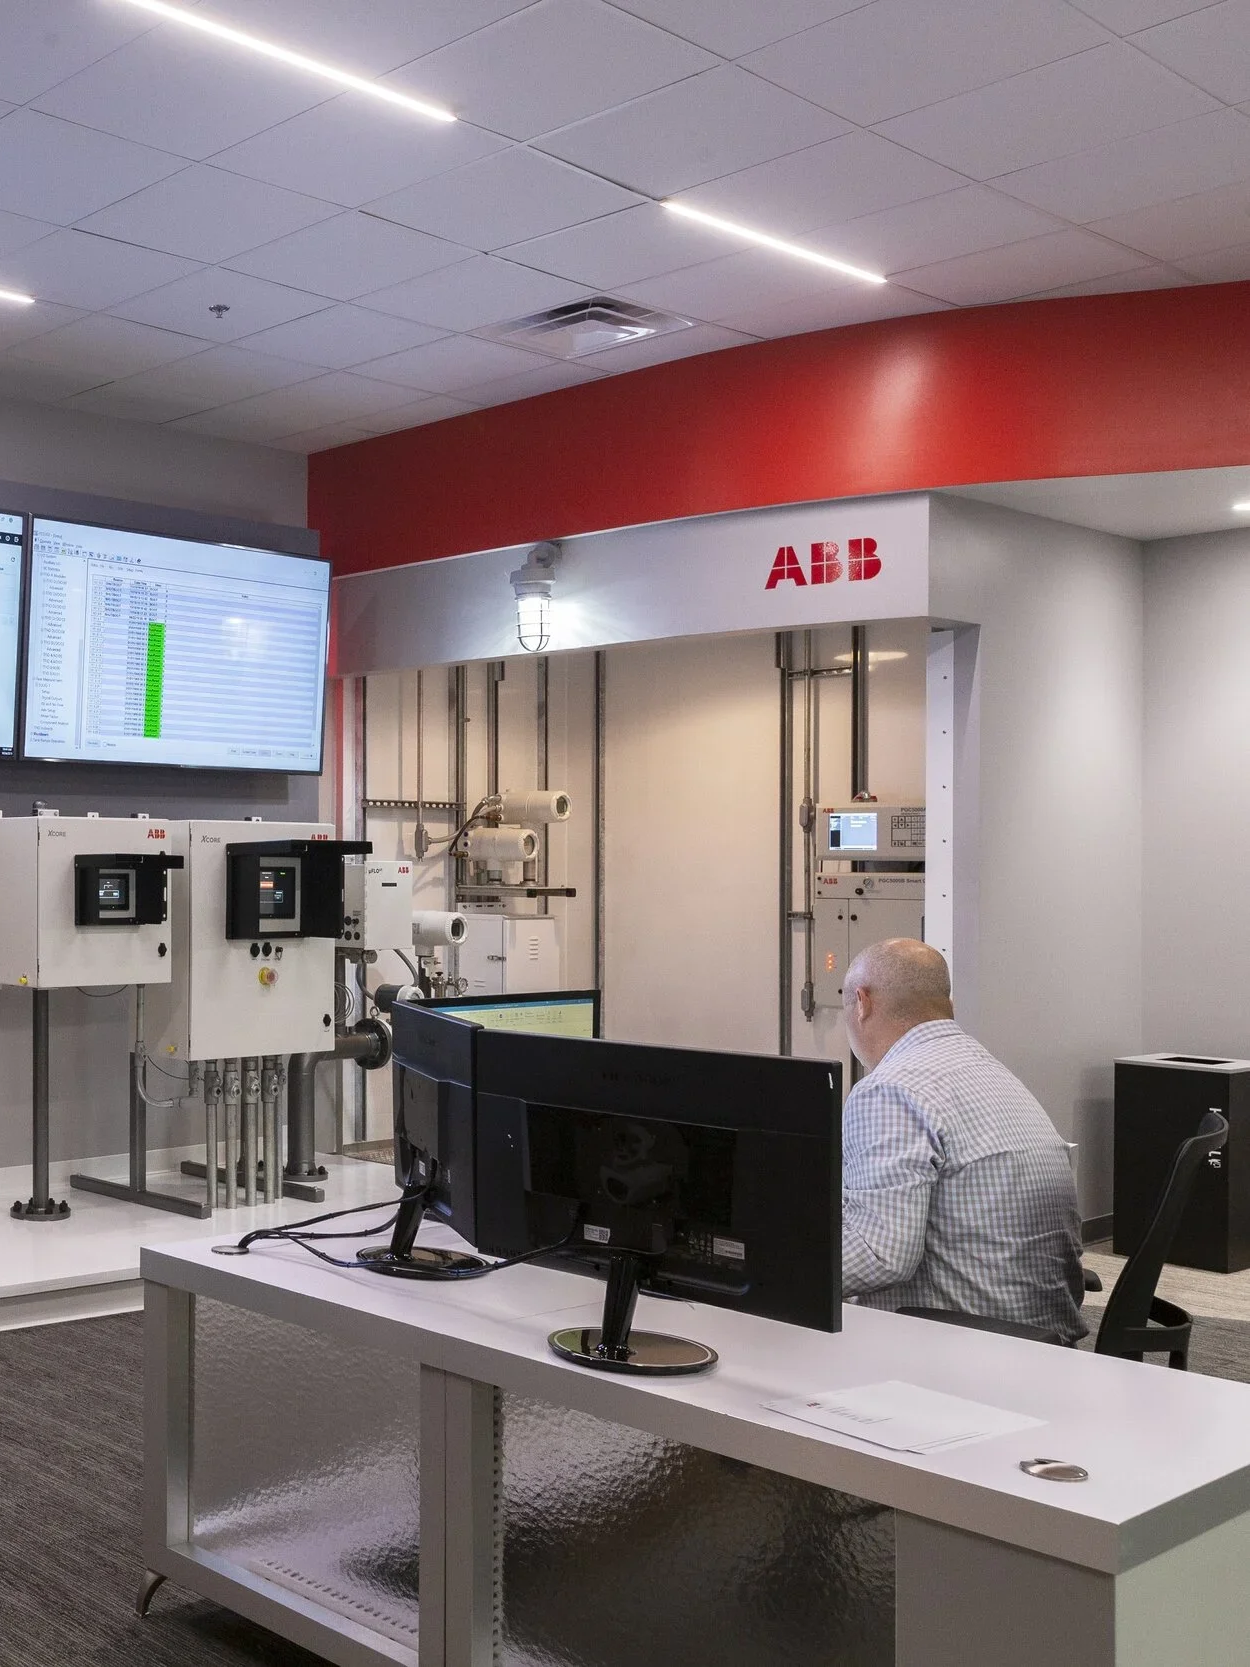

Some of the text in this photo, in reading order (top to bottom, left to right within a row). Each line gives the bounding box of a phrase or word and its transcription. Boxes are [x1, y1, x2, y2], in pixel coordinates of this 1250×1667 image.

[764, 537, 882, 590] ABB
[147, 829, 165, 839] ABB
[397, 866, 410, 874] ABB
